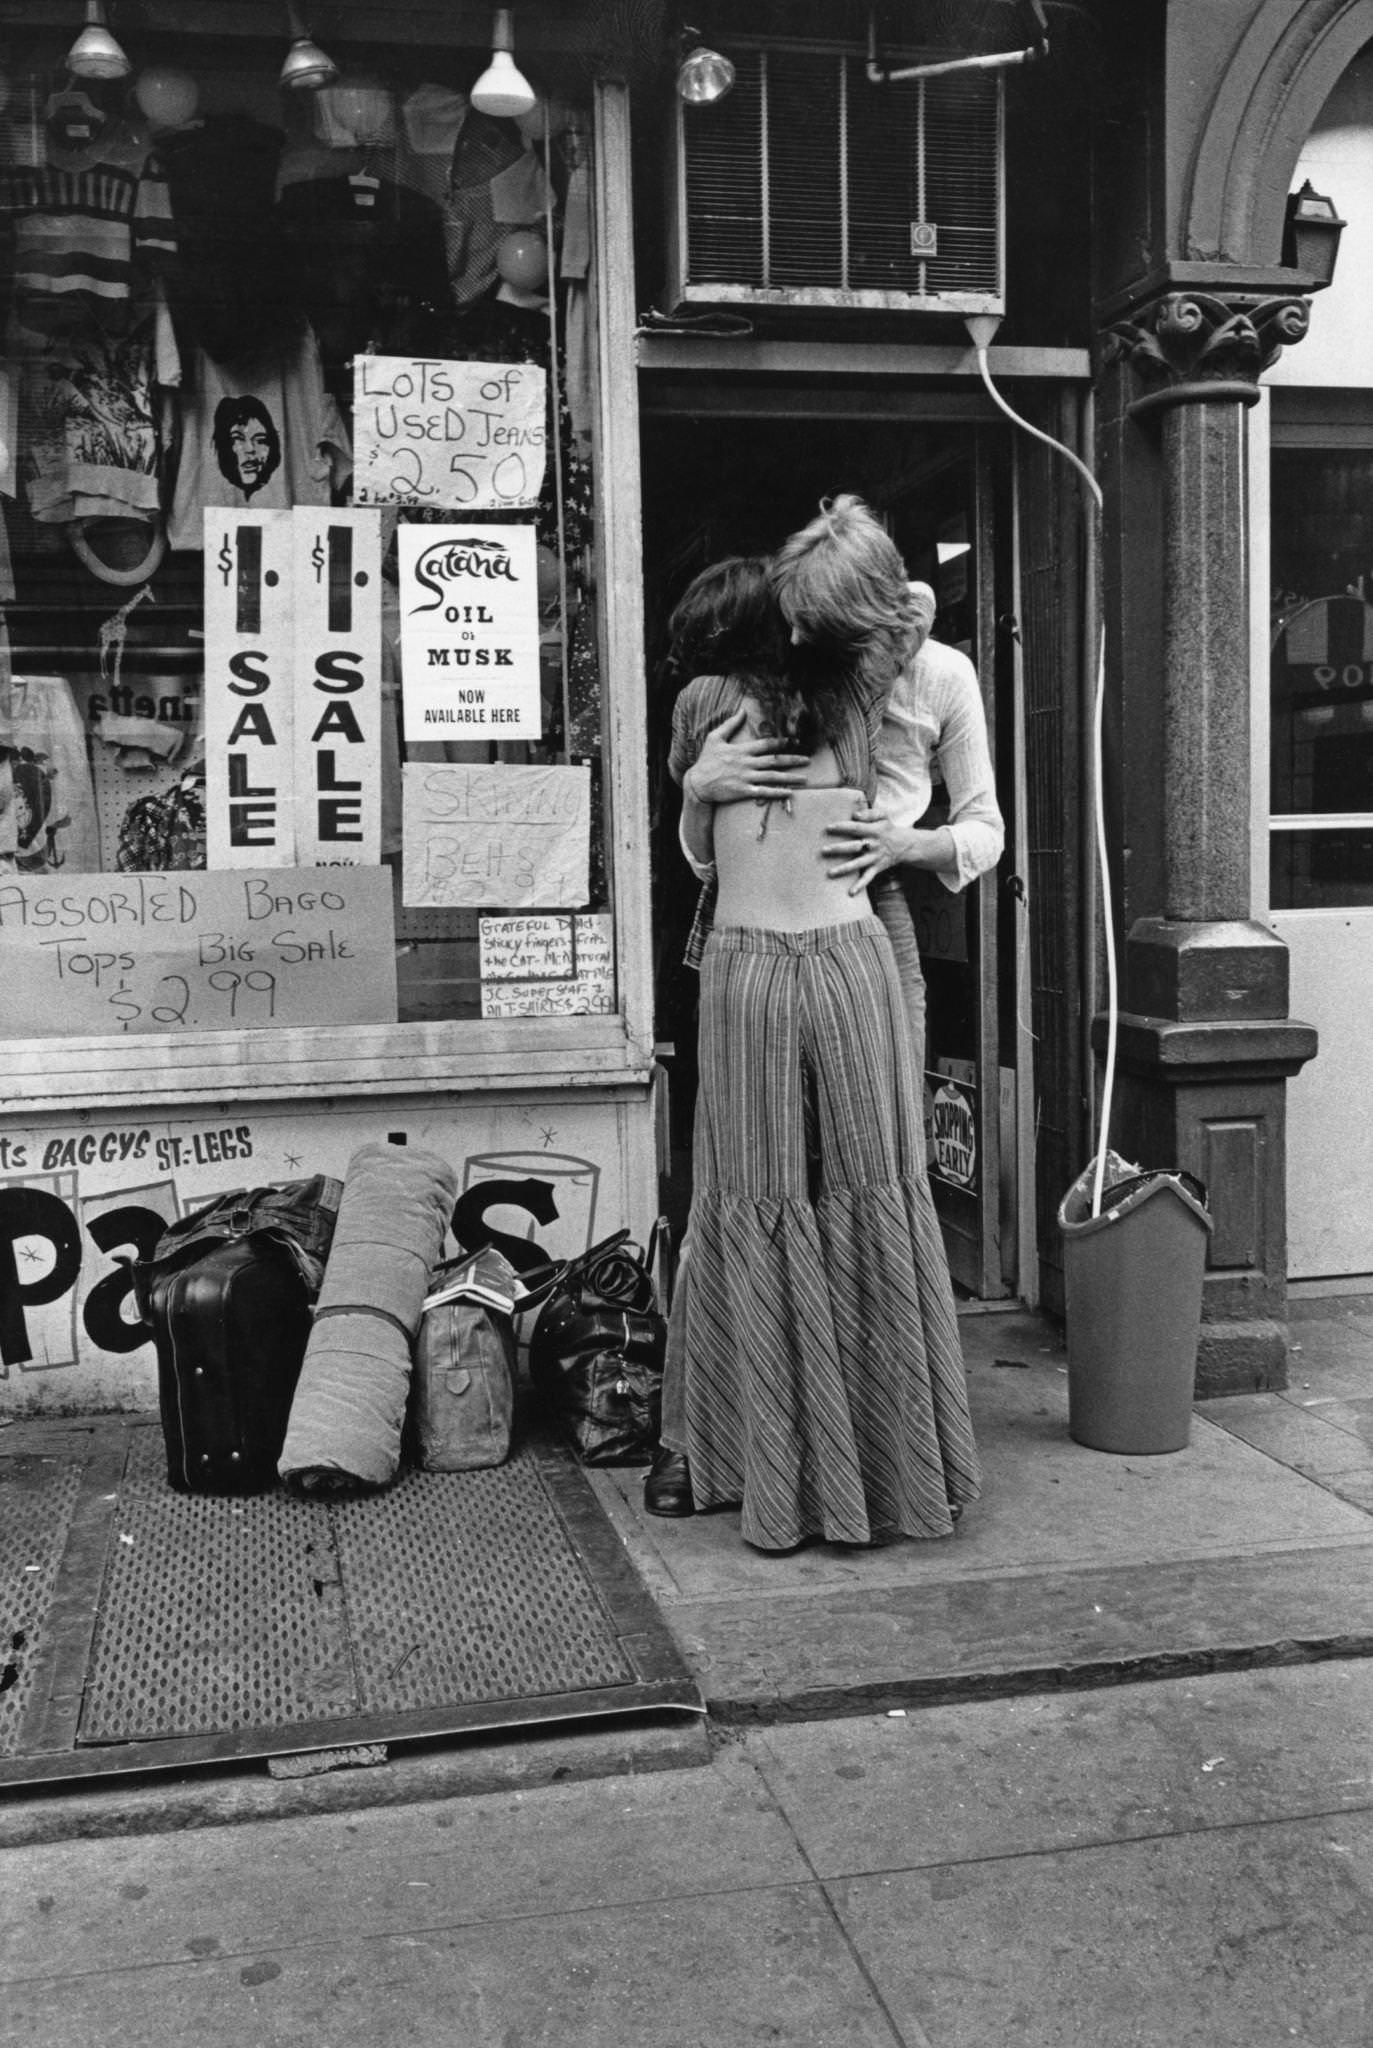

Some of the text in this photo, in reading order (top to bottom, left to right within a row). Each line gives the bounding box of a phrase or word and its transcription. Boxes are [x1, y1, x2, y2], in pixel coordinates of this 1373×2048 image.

[445, 605, 494, 623] OIL
[427, 648, 514, 666] MUSK
[424, 708, 521, 723] AVAILABLE HERE
[458, 689, 485, 703] NOW
[227, 650, 278, 847] SALE
[311, 650, 366, 842] SALE
[108, 971, 276, 1031] $2.99
[42, 1130, 150, 1170] BAGGYS
[938, 1139, 970, 1178] EARLY
